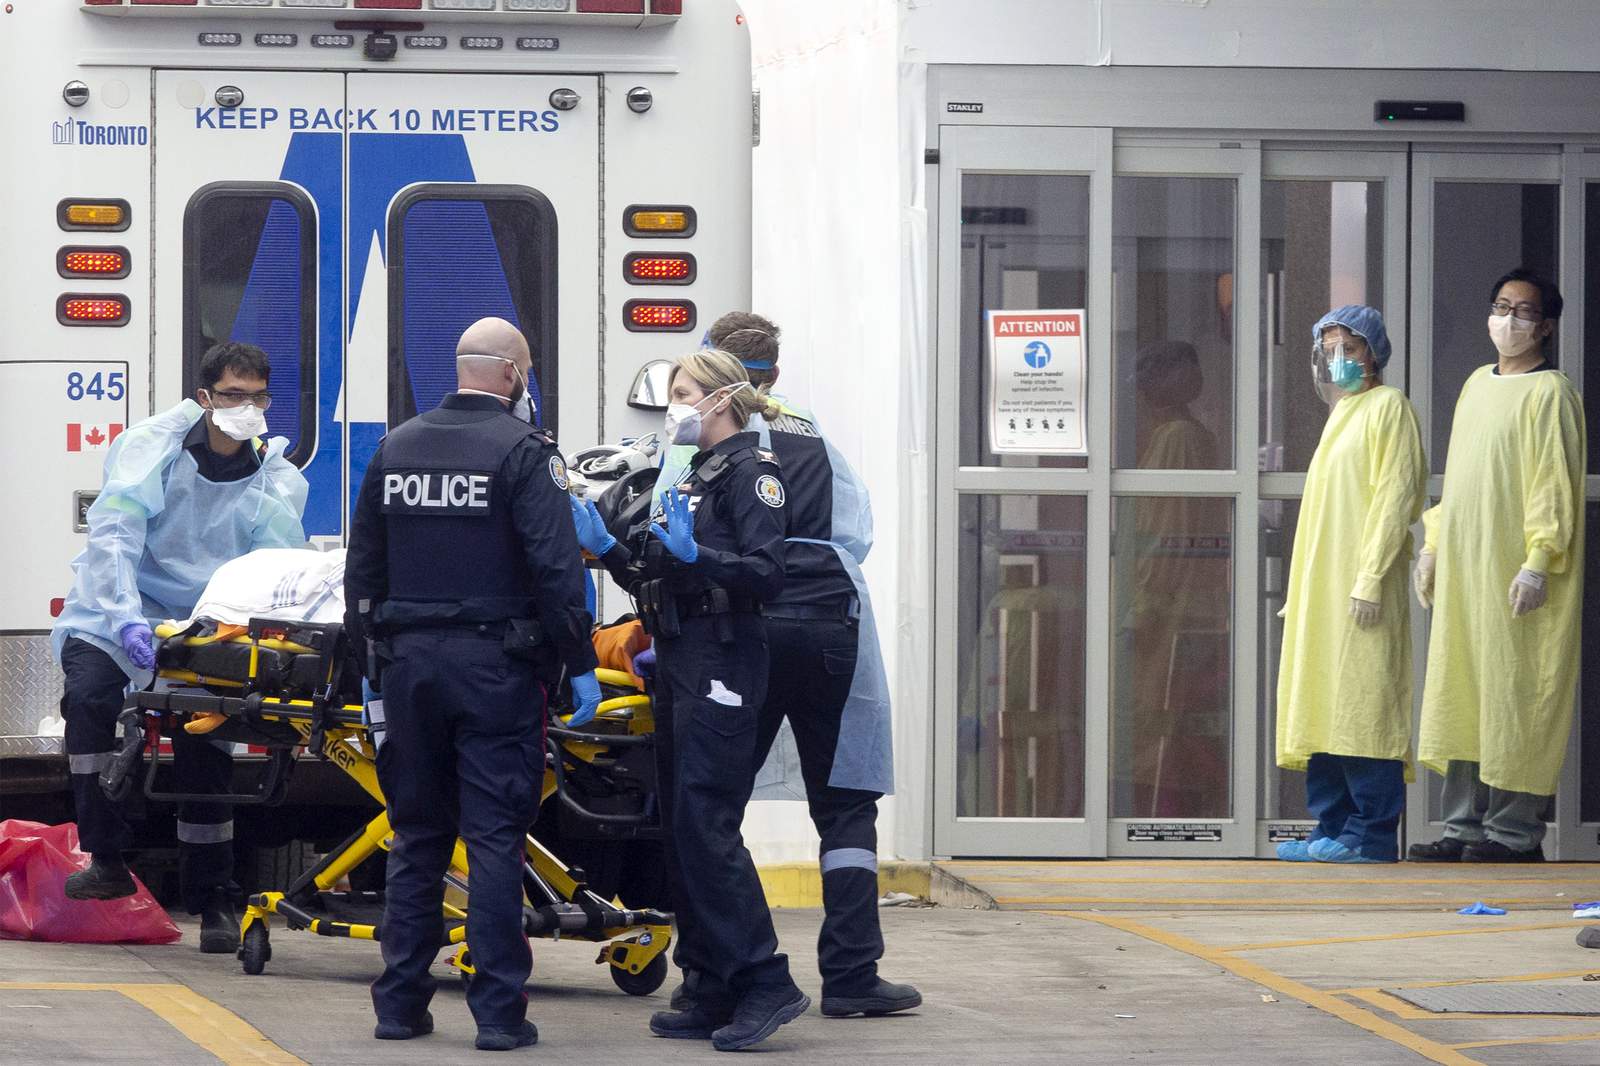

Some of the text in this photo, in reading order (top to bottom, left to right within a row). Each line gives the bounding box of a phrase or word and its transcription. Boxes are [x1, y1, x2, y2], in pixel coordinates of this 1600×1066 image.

[195, 107, 560, 132] KEEP BACK 10 METERS
[999, 320, 1075, 333] ATTENTION
[67, 371, 126, 401] 845
[383, 473, 490, 508] POLICE
